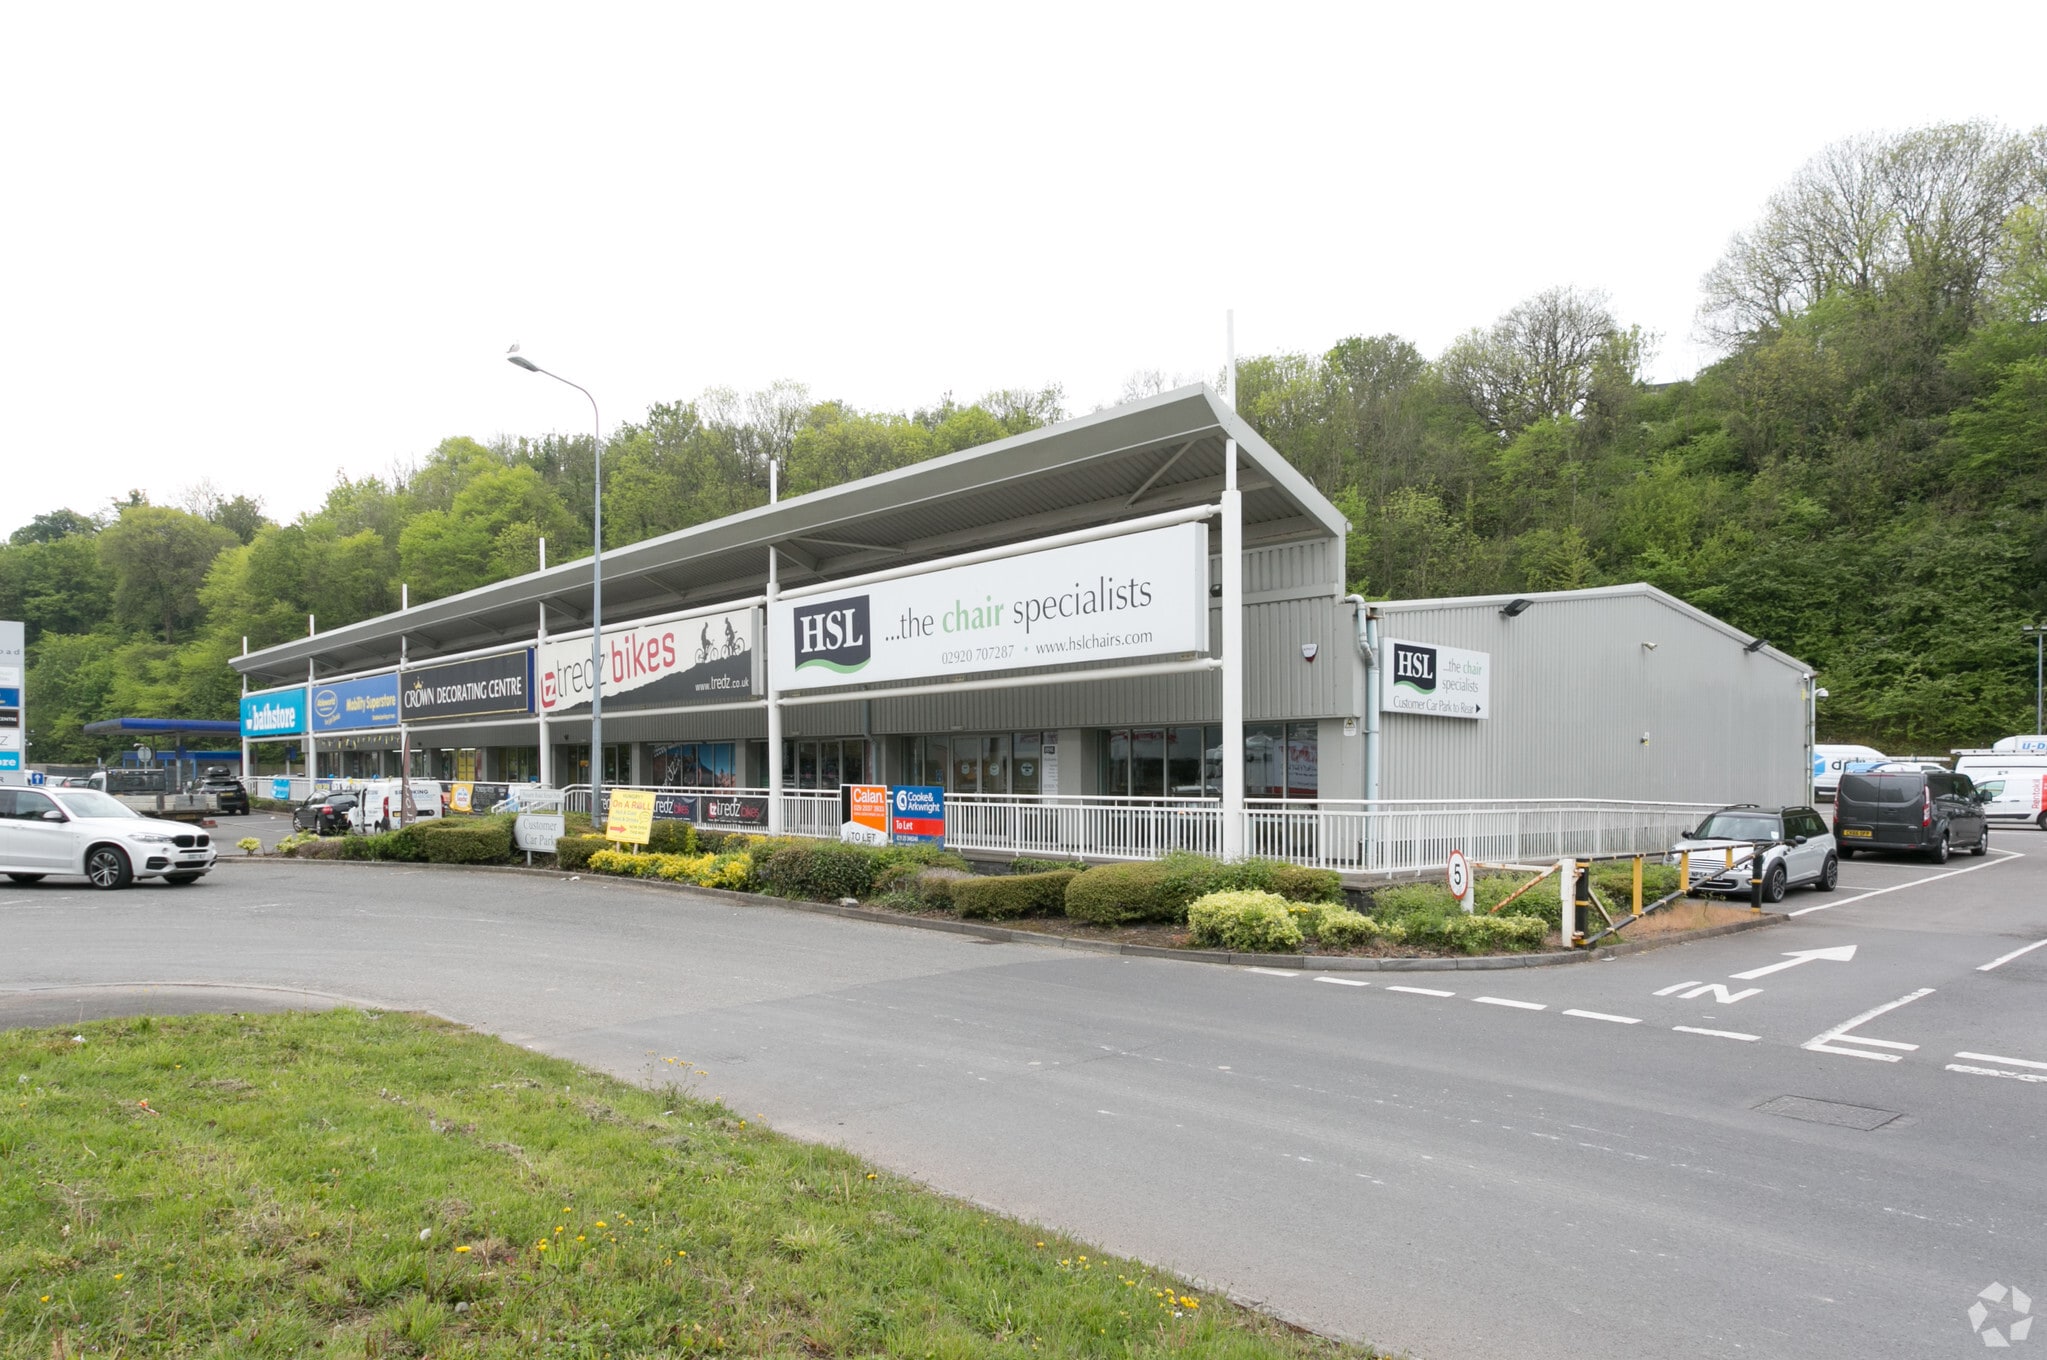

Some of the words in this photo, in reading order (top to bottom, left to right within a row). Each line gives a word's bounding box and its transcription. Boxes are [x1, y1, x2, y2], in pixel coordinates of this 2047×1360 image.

[942, 595, 1004, 633] chair
[1013, 576, 1152, 634] specialists
[800, 608, 863, 653] HSL
[611, 632, 676, 683] bikes
[942, 650, 973, 664] 02920
[976, 645, 1015, 662] 707287
[1036, 632, 1153, 655] www.hslchairs.com
[1397, 651, 1433, 679] HSL
[1462, 660, 1482, 676] chair
[404, 687, 434, 708] CROWN
[437, 681, 487, 704] DECORATING
[488, 677, 522, 698] CENTRE
[694, 674, 750, 692] www.tredz.co.uk
[1442, 677, 1479, 694] specialists
[367, 694, 396, 711] Superstore
[1393, 695, 1425, 709] Customer
[1426, 698, 1438, 711] Car
[1439, 700, 1452, 712] Park
[1453, 702, 1460, 713] to
[1460, 702, 1474, 714] Rear
[252, 703, 296, 731] bathstore
[2031, 779, 2041, 809] Rentokil
[624, 801, 630, 809] A
[673, 802, 689, 815] bikes
[717, 797, 741, 817] tredz
[740, 803, 760, 818] bikes
[907, 801, 940, 814] Arkwright
[523, 819, 557, 832] Customer
[895, 820, 903, 830] To
[903, 820, 913, 830] Let
[524, 833, 538, 845] Car
[540, 834, 555, 847] Park
[851, 832, 860, 841] TO
[862, 832, 876, 842] LET
[1454, 863, 1462, 885] 5
[1652, 981, 1765, 1004] IN
